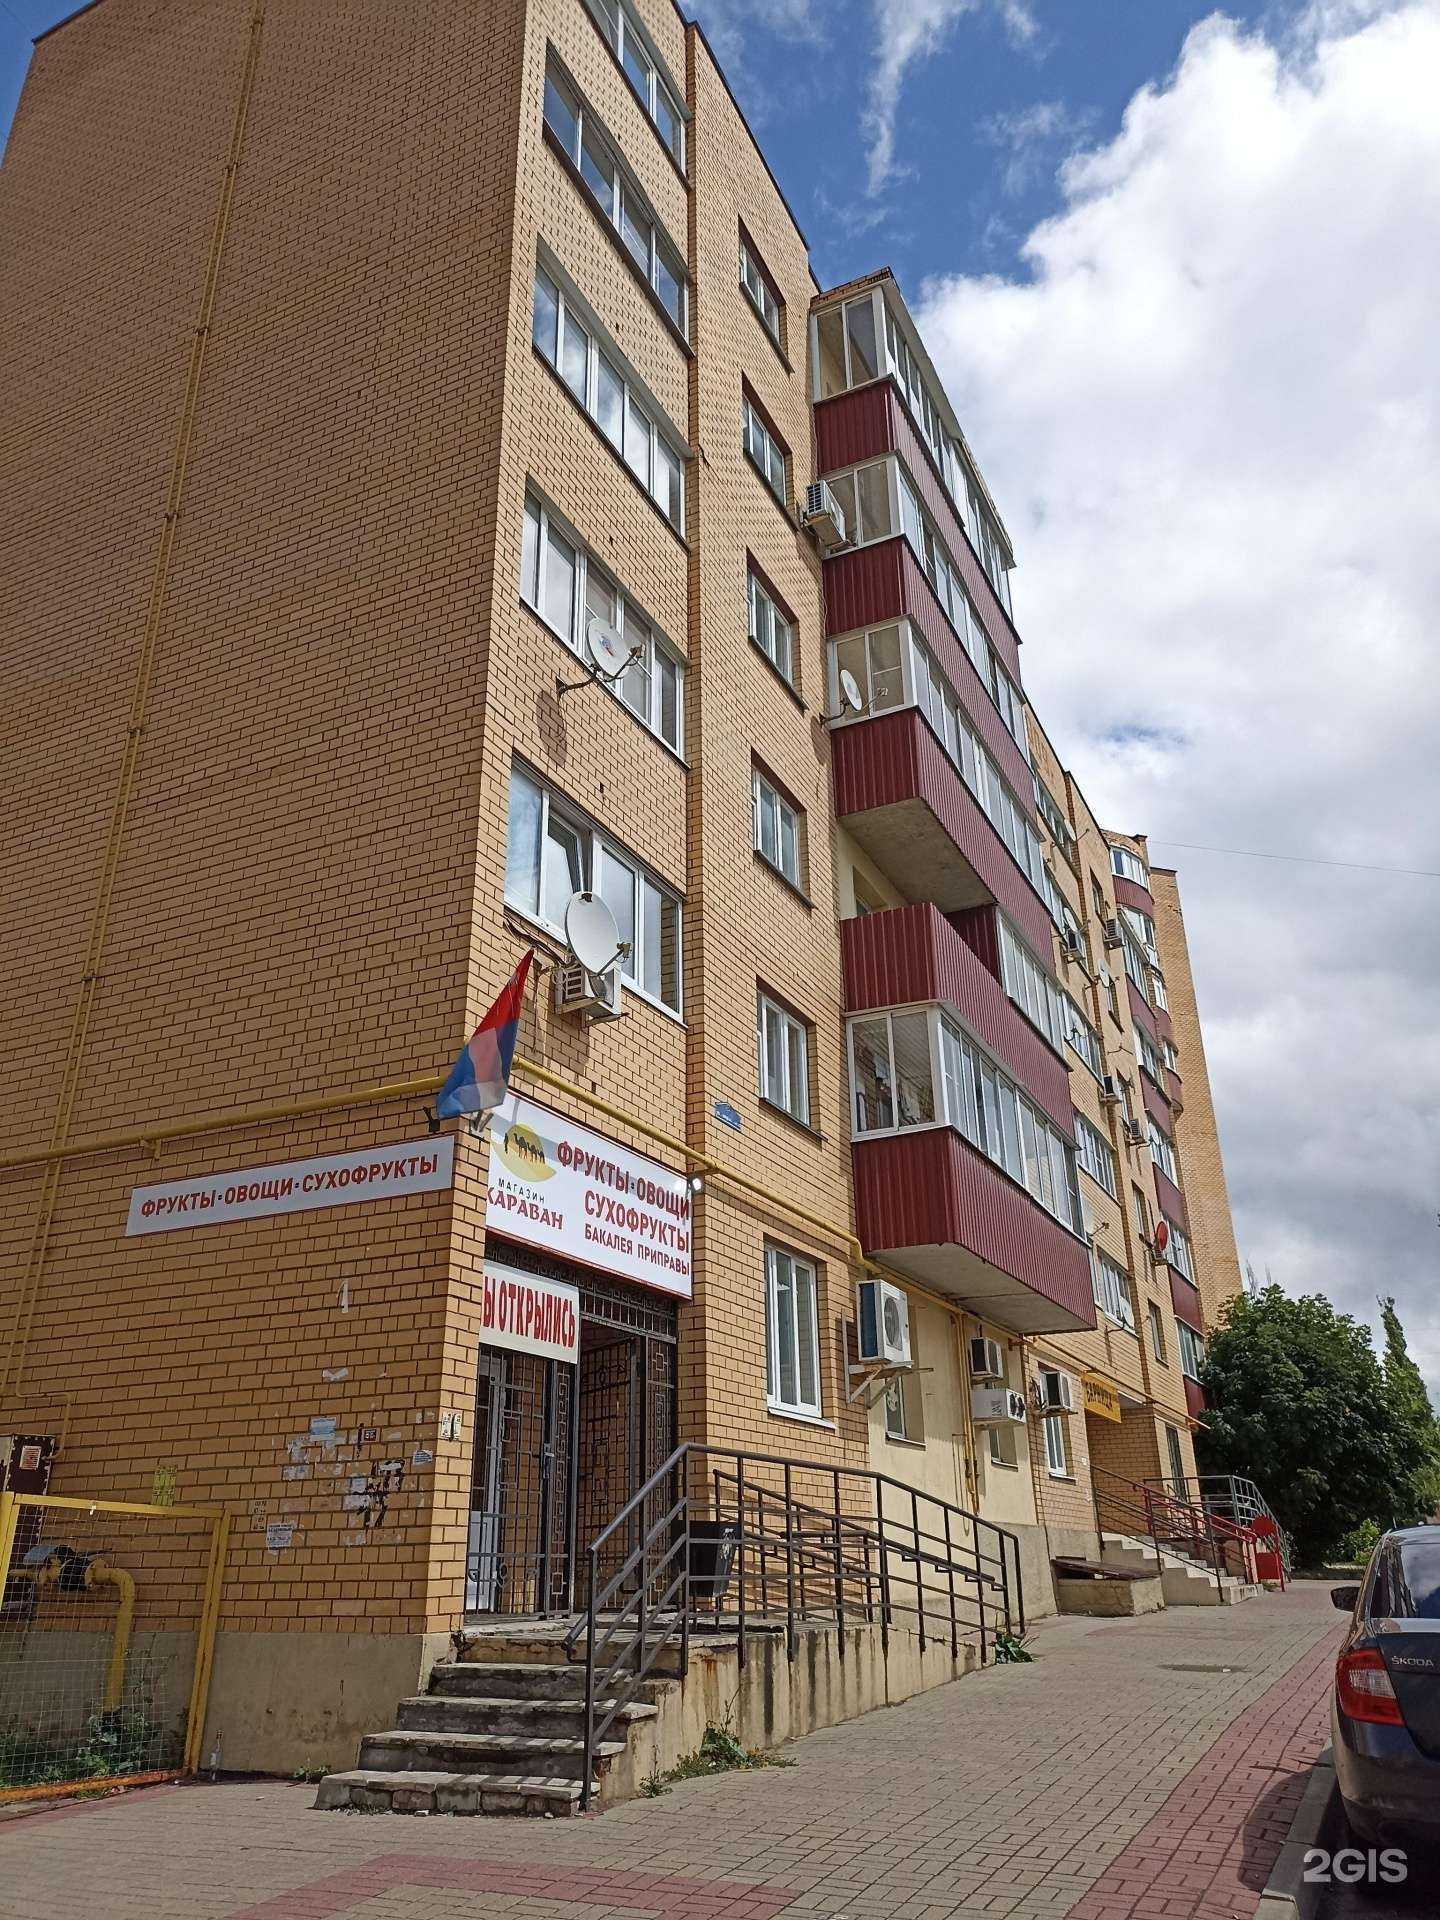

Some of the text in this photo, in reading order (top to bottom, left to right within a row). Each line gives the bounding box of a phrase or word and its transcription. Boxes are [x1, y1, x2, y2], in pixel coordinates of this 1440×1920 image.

[140, 1154, 438, 1218] ФРУКТЫ ОВОЩИ СУХОФРУКТЫ
[498, 1177, 545, 1204] МАГАЗИН
[557, 1141, 690, 1221] ФРУКТЫ ОВОЩИ
[584, 1190, 690, 1254] СУХОФРУКТЫ
[584, 1223, 690, 1276] БАКАЛЕЯ ПРИПРАВЫ
[498, 1280, 576, 1348] ОТКРЫЛИСЬ
